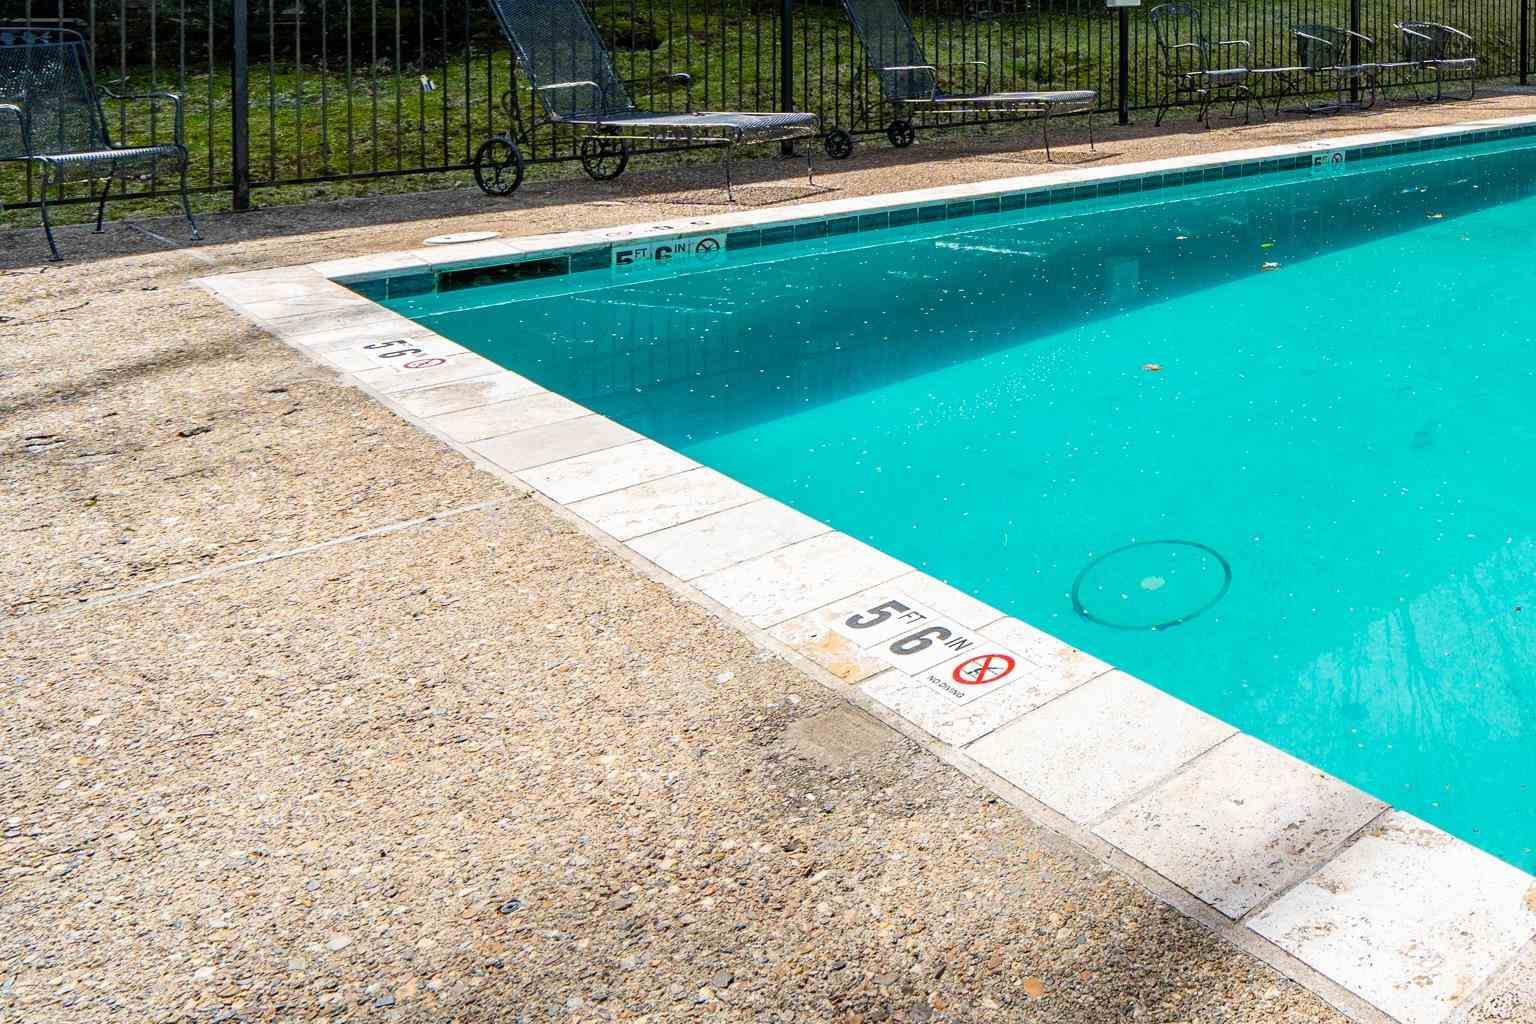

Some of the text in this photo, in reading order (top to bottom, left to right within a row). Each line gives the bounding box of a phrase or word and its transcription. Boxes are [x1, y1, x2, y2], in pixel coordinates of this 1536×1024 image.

[616, 251, 634, 265] 5
[635, 248, 648, 258] FT
[675, 243, 686, 253] IN
[845, 600, 974, 655] 5 FT 6 IN
